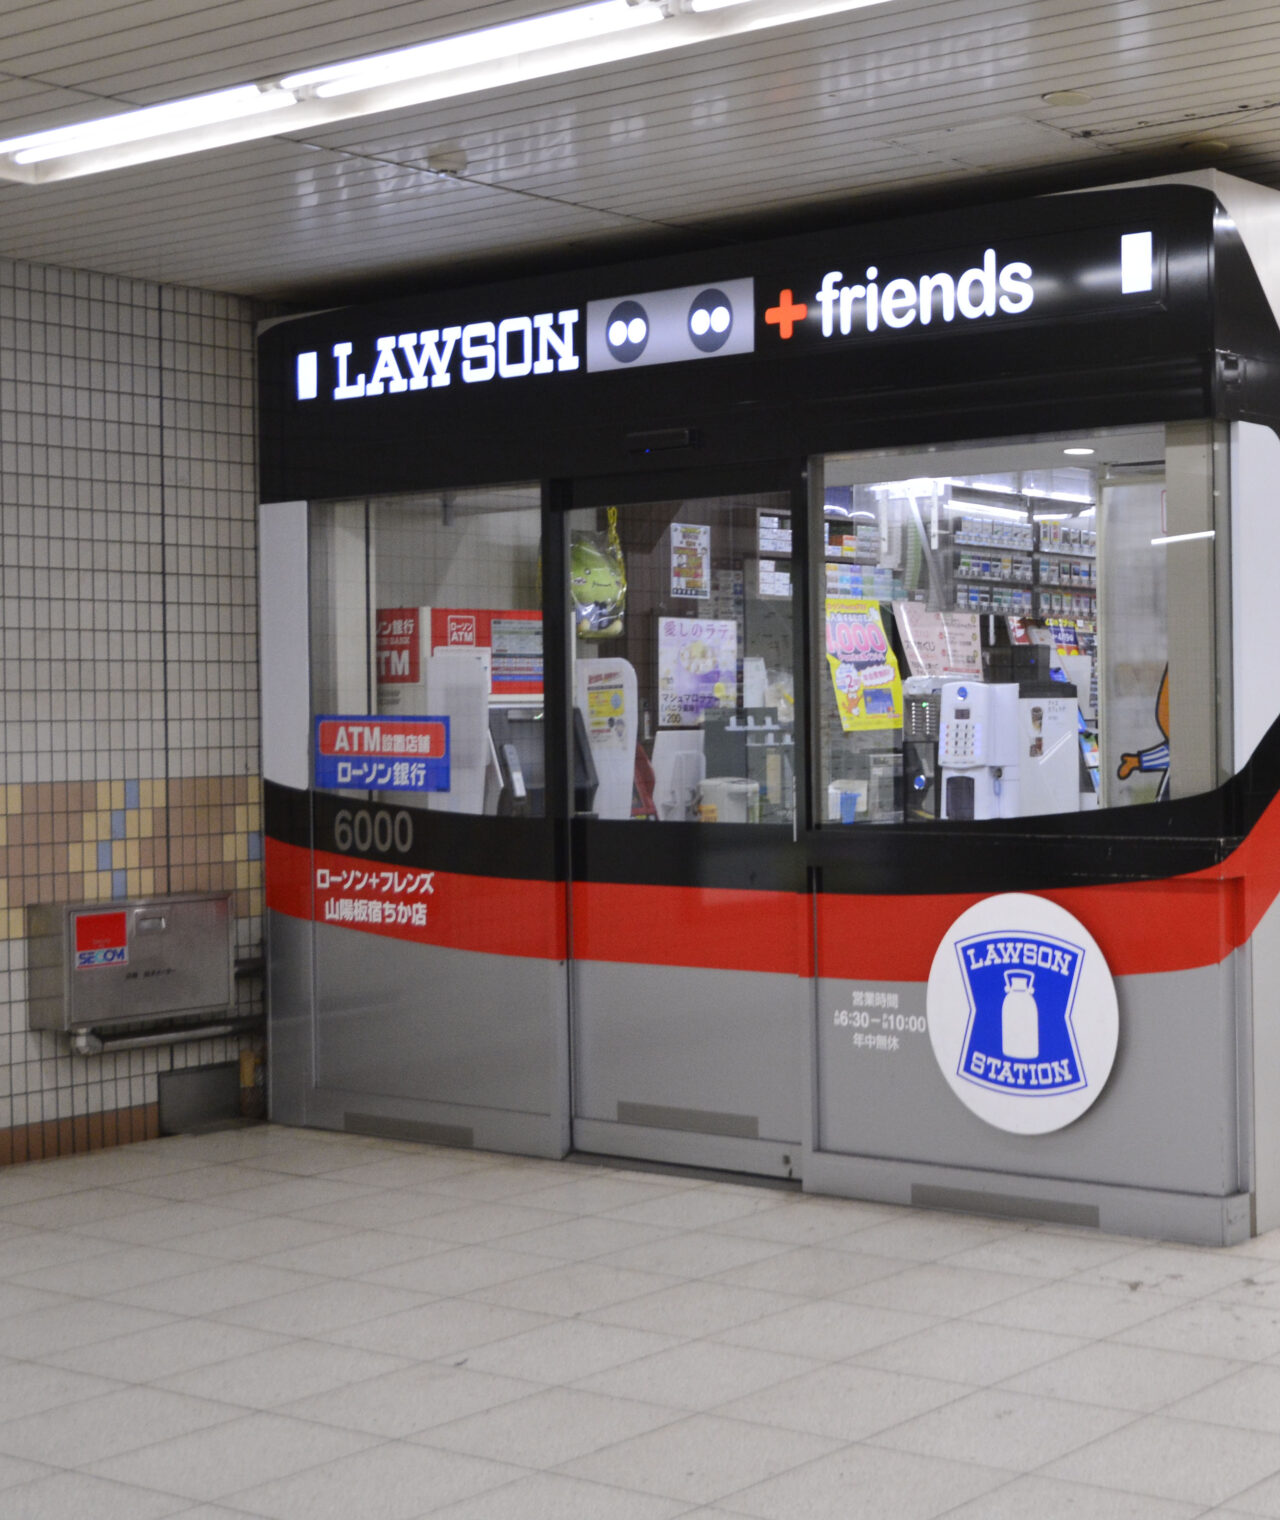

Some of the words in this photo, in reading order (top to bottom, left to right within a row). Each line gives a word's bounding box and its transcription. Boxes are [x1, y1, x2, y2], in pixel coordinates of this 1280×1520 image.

[333, 309, 579, 400] LAWSON
[816, 248, 1034, 337] friends
[450, 622, 473, 631] ローソン
[451, 631, 473, 642] ATM
[376, 649, 411, 676] TM
[334, 726, 430, 754] ATM設置店舗
[337, 762, 426, 786] ローソン銀行
[334, 809, 413, 852] 6000
[324, 896, 427, 926] 山陽板宿ちか店
[79, 947, 125, 966] SECOM
[966, 942, 1072, 976] LAWSON
[853, 1032, 899, 1050] 年中無休
[970, 1050, 1073, 1086] STATION
